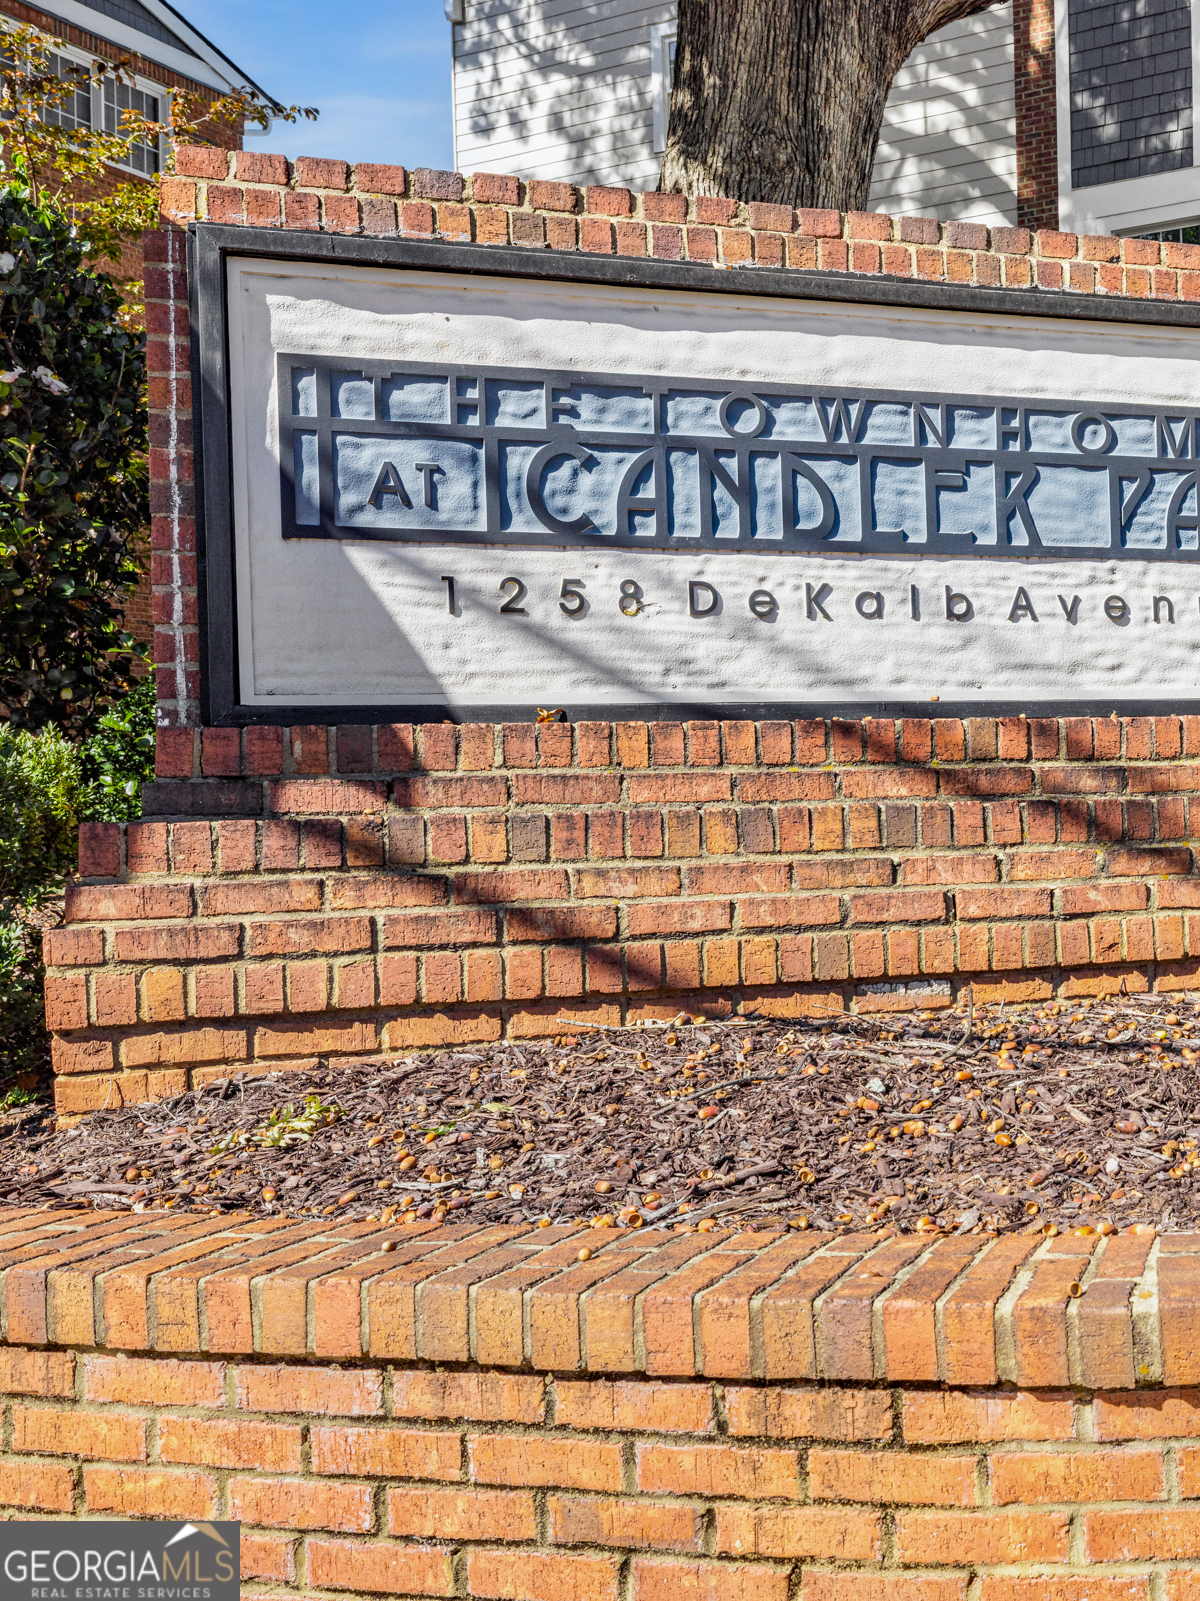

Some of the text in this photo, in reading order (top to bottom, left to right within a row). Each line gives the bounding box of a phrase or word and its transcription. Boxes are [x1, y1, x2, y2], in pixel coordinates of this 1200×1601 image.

[361, 371, 575, 430] THE
[367, 461, 438, 508] AT
[526, 441, 1042, 546] CANDLER
[441, 575, 644, 617] 1258
[688, 579, 972, 622] DeKalb
